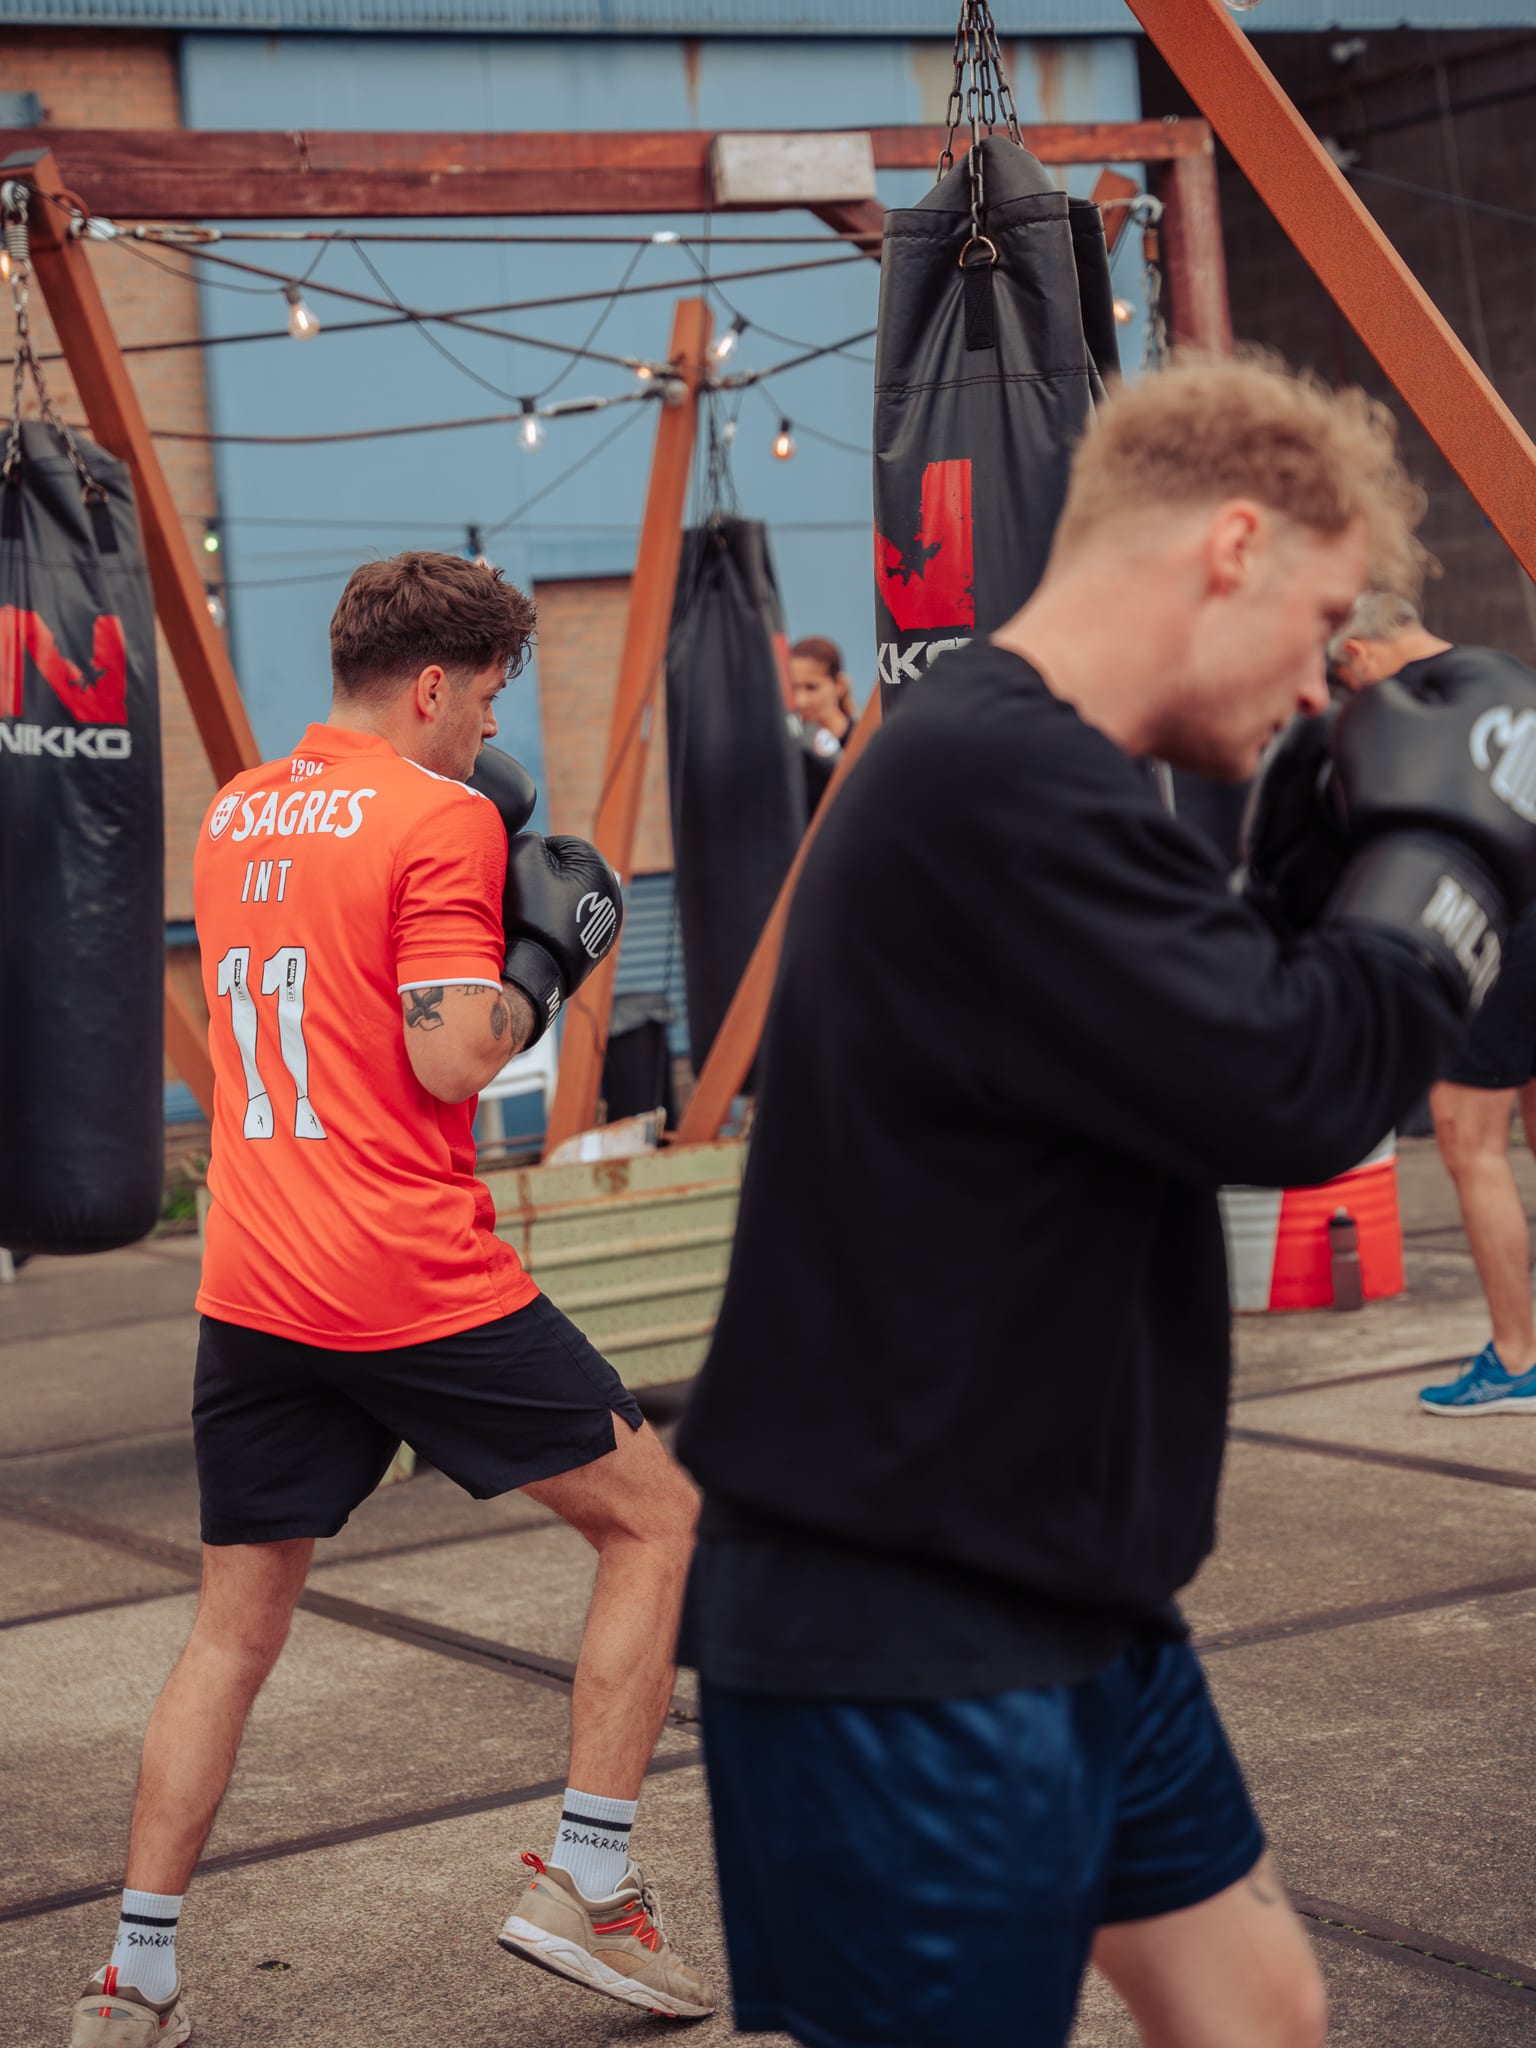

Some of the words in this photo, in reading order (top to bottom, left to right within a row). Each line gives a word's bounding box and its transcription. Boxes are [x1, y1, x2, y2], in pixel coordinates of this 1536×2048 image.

[231, 788, 377, 842] SAGRES
[241, 859, 293, 903] INT
[287, 959, 297, 984] bwin
[217, 946, 328, 1140] 11
